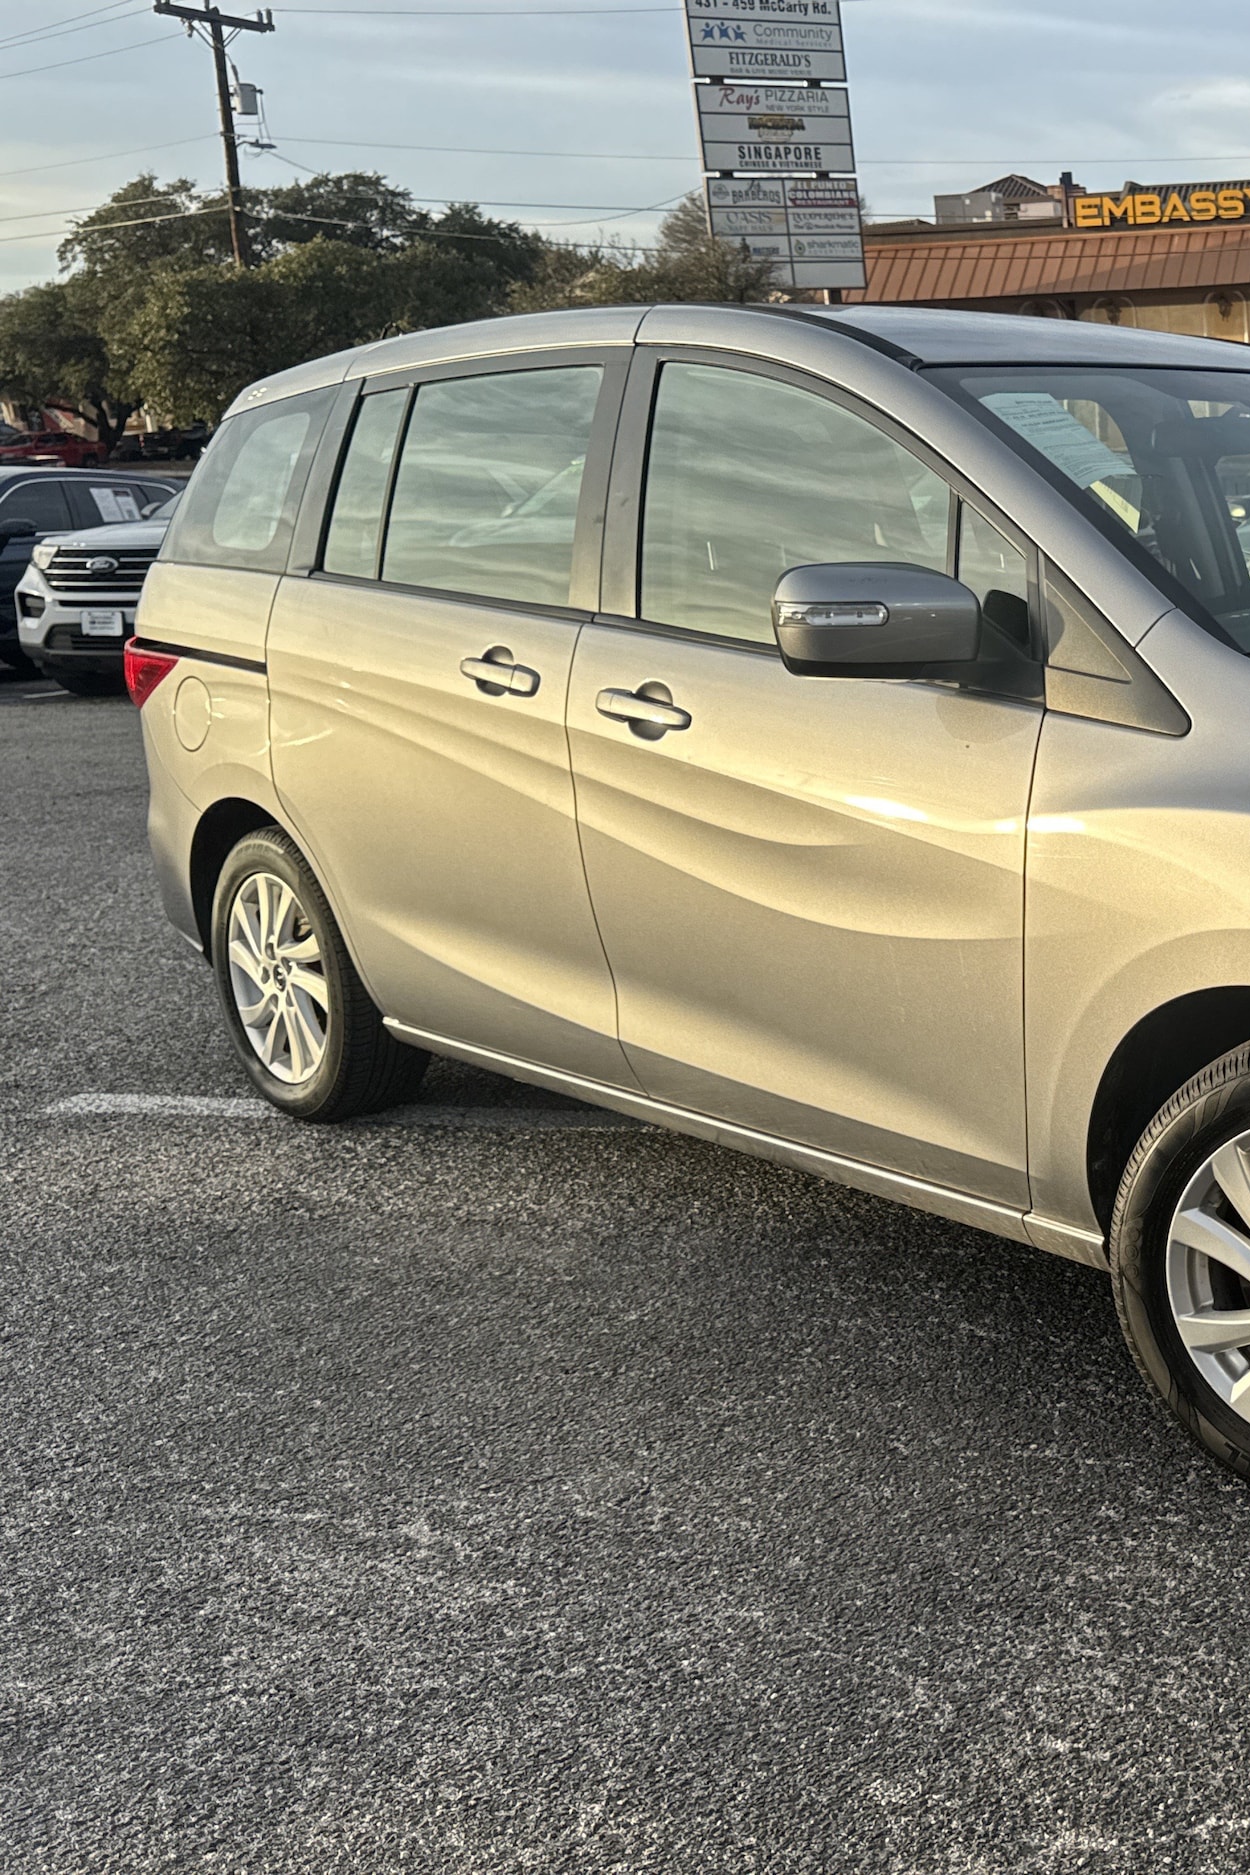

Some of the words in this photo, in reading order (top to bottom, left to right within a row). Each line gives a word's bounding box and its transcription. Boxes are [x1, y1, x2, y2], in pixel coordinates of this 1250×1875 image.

[695, 0, 718, 8] 431
[732, 0, 755, 10] 459
[759, 0, 809, 16] McCarty
[812, 1, 832, 15] Rd.
[752, 23, 833, 42] Community
[756, 38, 792, 46] Medical
[795, 39, 832, 48] Services
[728, 51, 812, 68] FITZGERALD'S
[718, 87, 761, 110] Ray's
[764, 89, 829, 103] PIZZARIA
[766, 104, 784, 112] NEW
[785, 105, 805, 113] YORK
[807, 105, 829, 113] STYLE
[738, 145, 822, 160] SINGAPORE
[739, 160, 770, 168] CHINESE
[779, 160, 823, 169] VIETNAMESE
